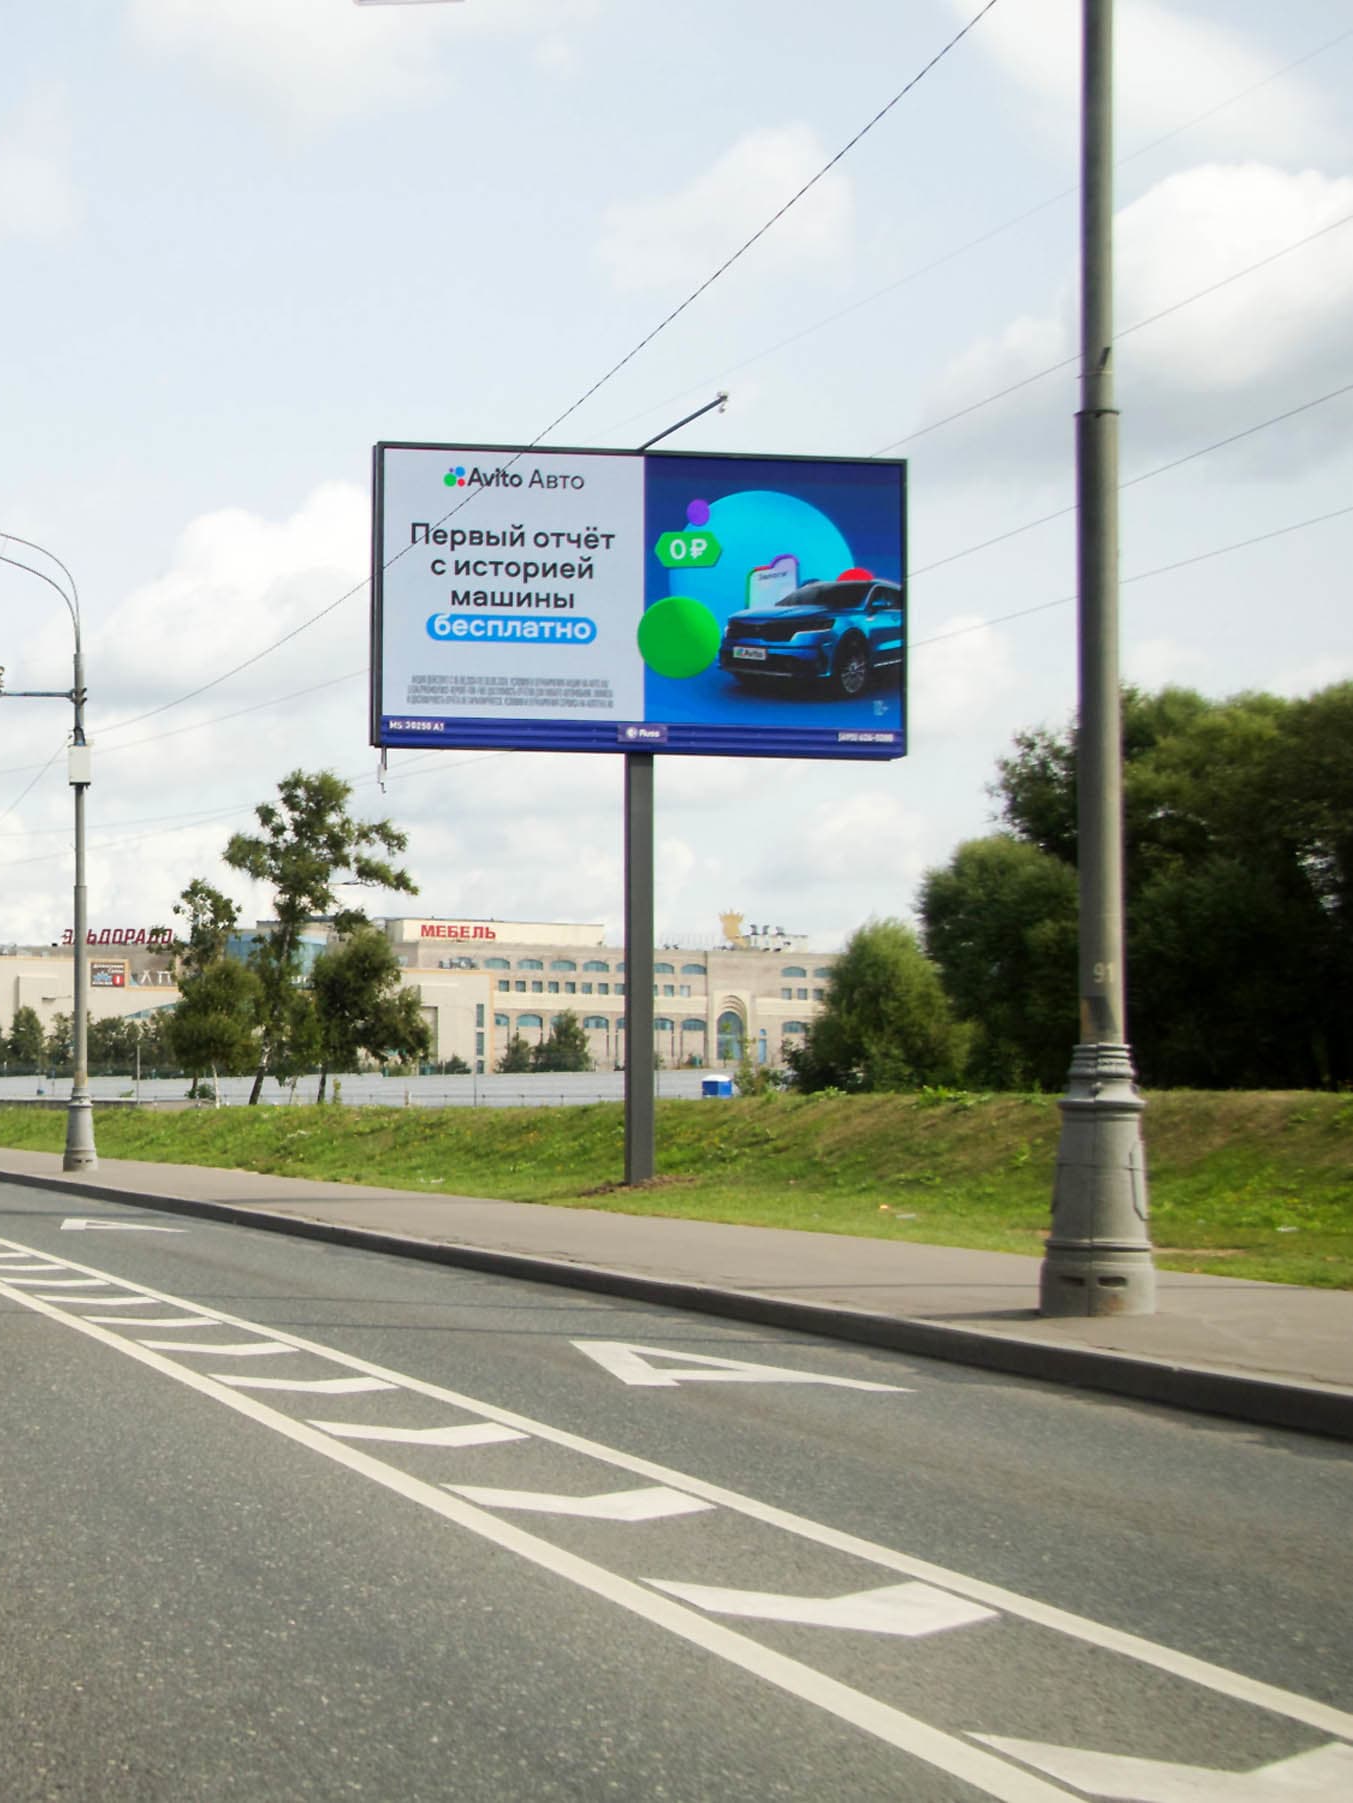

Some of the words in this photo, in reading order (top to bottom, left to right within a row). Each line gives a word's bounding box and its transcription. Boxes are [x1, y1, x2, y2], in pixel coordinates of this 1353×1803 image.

[467, 468, 523, 488] Avito
[528, 469, 585, 490] Авто
[411, 522, 525, 551] Первый
[533, 526, 616, 549] отчёт
[430, 558, 447, 576] с
[454, 556, 594, 583] историей
[451, 589, 574, 609] машины
[433, 613, 592, 639] бесплатно
[62, 928, 173, 945] ЭЬДОРАДО
[420, 924, 497, 940] МЕБЕЛЬ
